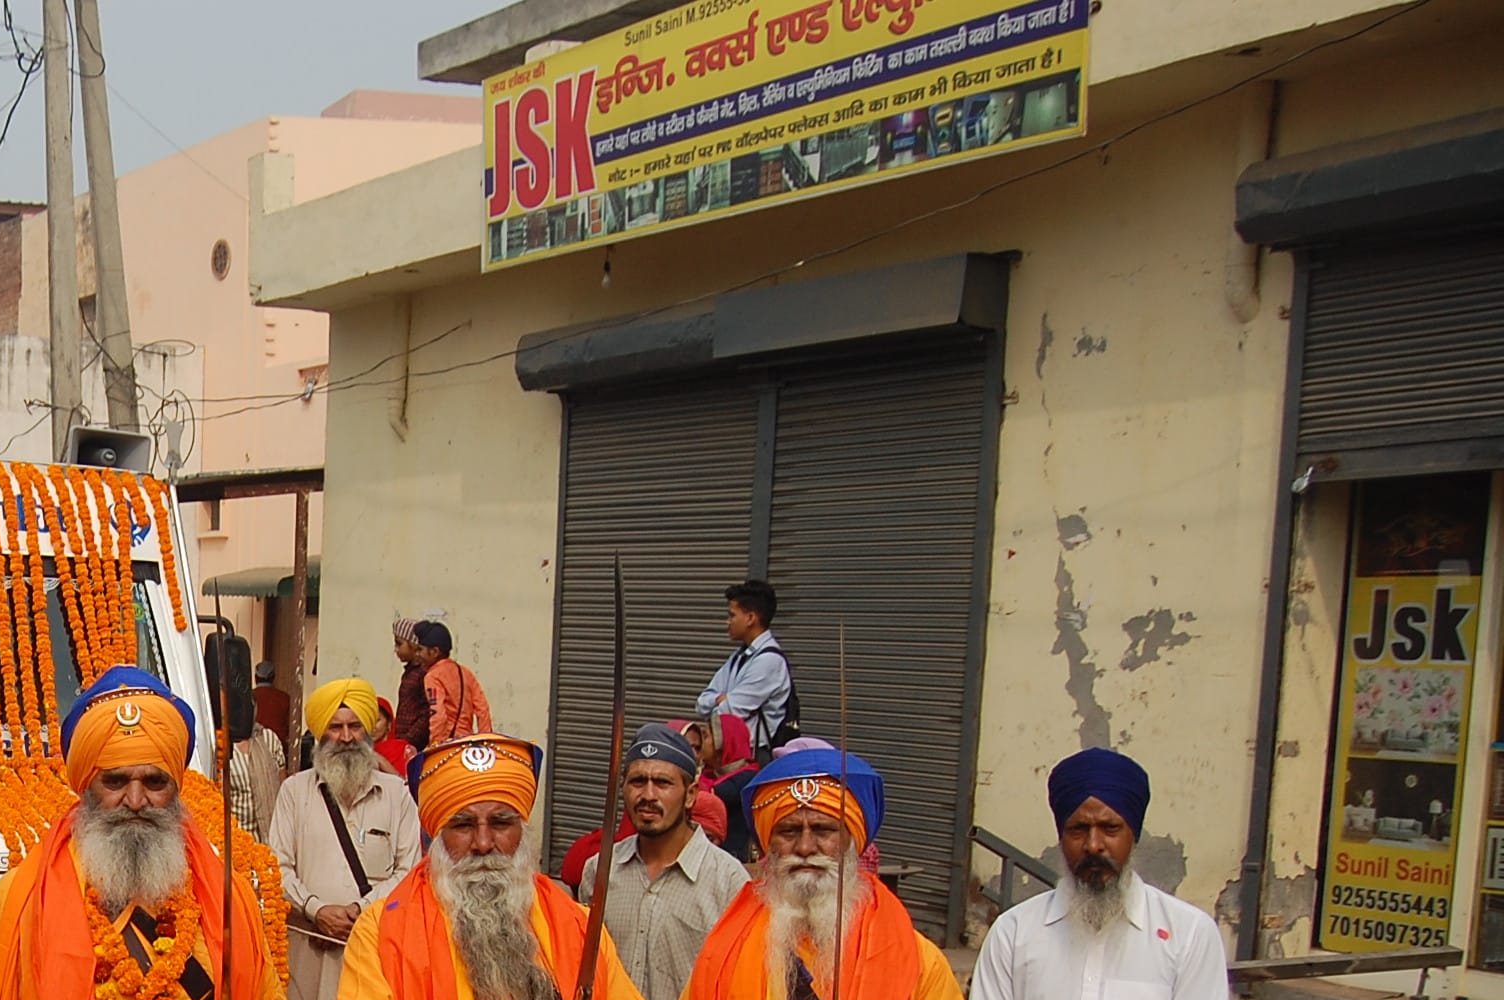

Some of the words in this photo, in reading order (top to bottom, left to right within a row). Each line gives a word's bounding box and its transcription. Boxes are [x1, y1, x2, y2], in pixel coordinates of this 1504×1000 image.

[624, 28, 653, 47] Sunil
[654, 18, 683, 36] Saini
[685, 9, 760, 77] वर्क्स
[766, 1, 832, 55] एण्ड
[488, 68, 598, 217] JSK
[643, 154, 672, 175] हमारे
[832, 100, 866, 121] आदि
[868, 95, 888, 113] का
[892, 85, 926, 106] काम
[928, 76, 948, 98] भी
[952, 67, 991, 91] किया
[995, 56, 1036, 78] जाता
[1352, 583, 1476, 667] Jsk
[1335, 851, 1389, 879] Sunil
[1395, 857, 1451, 887] Saini
[1331, 885, 1448, 919] 9255555443
[1329, 914, 1445, 948] 7015097325
